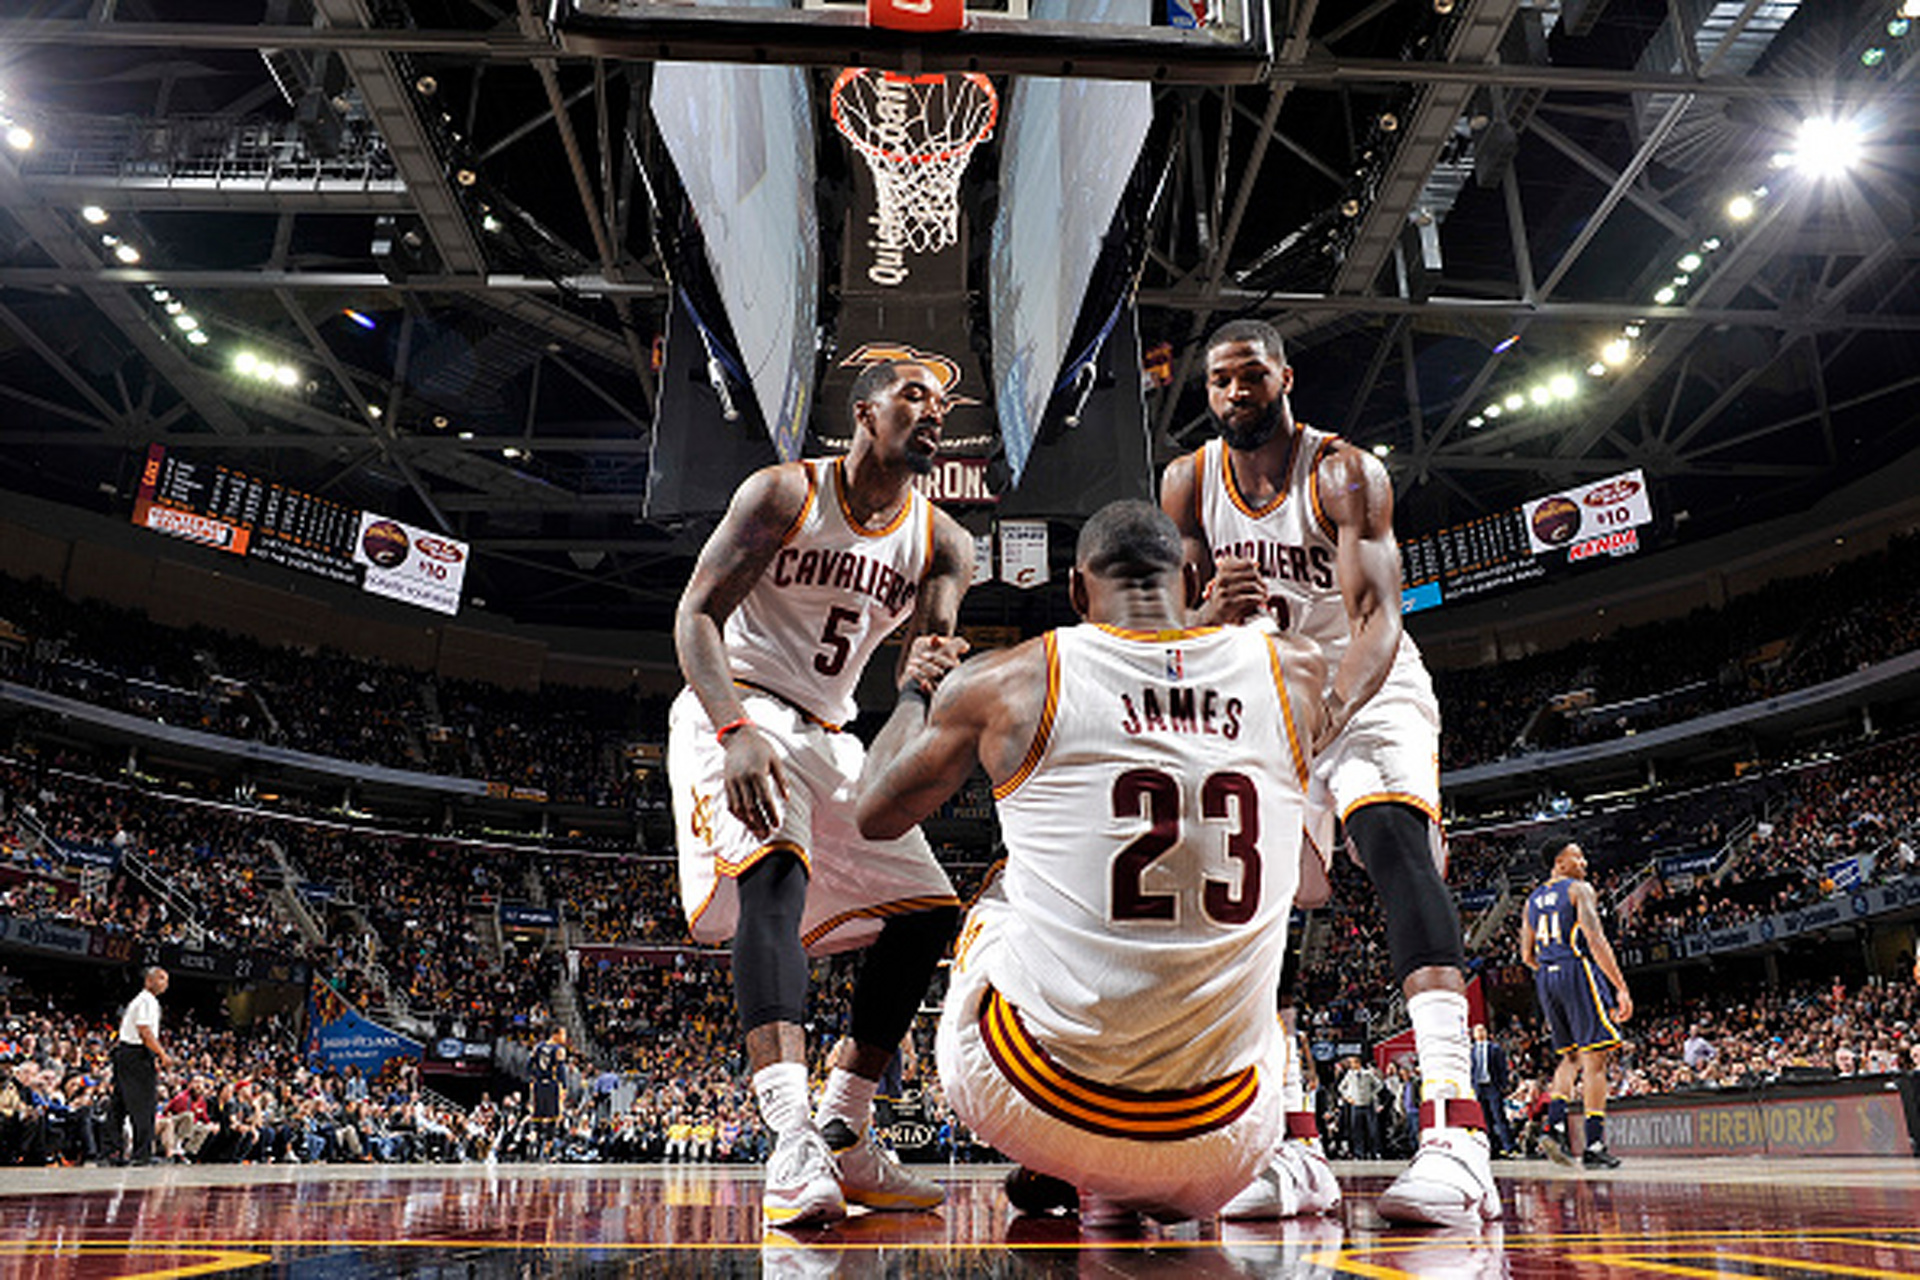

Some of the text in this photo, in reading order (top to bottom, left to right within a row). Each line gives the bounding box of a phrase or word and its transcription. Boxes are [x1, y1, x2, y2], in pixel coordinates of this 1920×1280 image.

[1215, 540, 1334, 589] ALIERS
[813, 605, 860, 677] 5
[1121, 687, 1243, 741] JAMES
[1110, 767, 1263, 925] 23
[1534, 910, 1563, 948] 44
[1606, 1103, 1836, 1147] PHANTOM FIREWORKS
